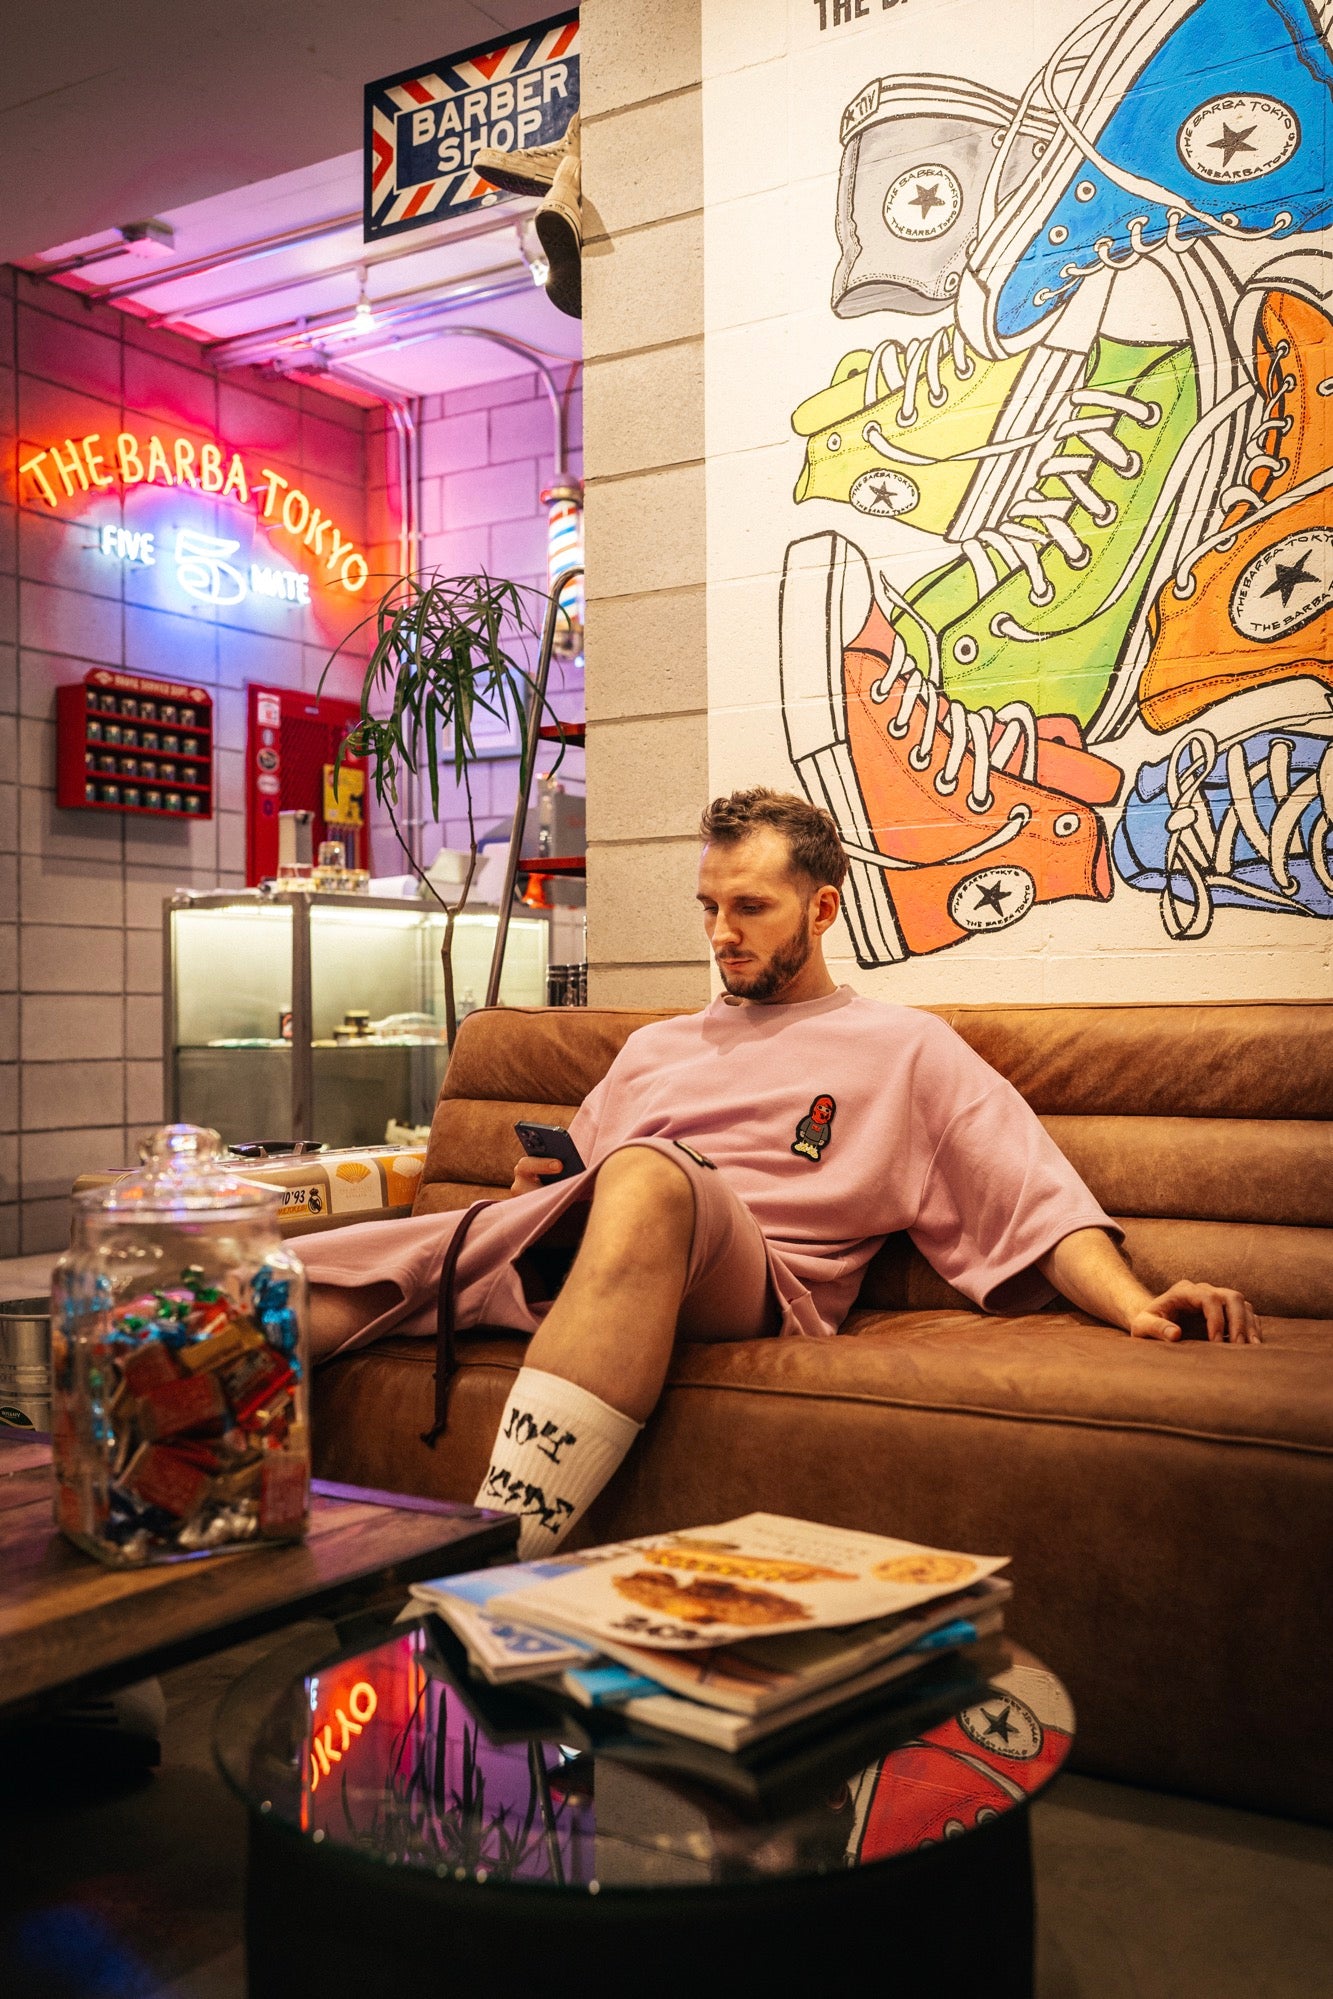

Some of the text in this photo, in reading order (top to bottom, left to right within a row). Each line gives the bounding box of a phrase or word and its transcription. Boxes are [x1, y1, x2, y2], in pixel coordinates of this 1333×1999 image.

[412, 63, 568, 147] BARBER
[1183, 99, 1292, 158] THE BARBA TOKYO
[437, 109, 542, 172] SHOP
[1263, 132, 1296, 168] TOKYO
[19, 432, 369, 592] THE BARBA TOKYO
[101, 525, 156, 565] FIVE
[251, 563, 312, 605] MATE
[1236, 533, 1333, 618] THE BARBA TOKY
[1250, 593, 1331, 632] THE BARBA
[1014, 884, 1031, 914] TOKYO
[504, 1408, 576, 1464] JOY
